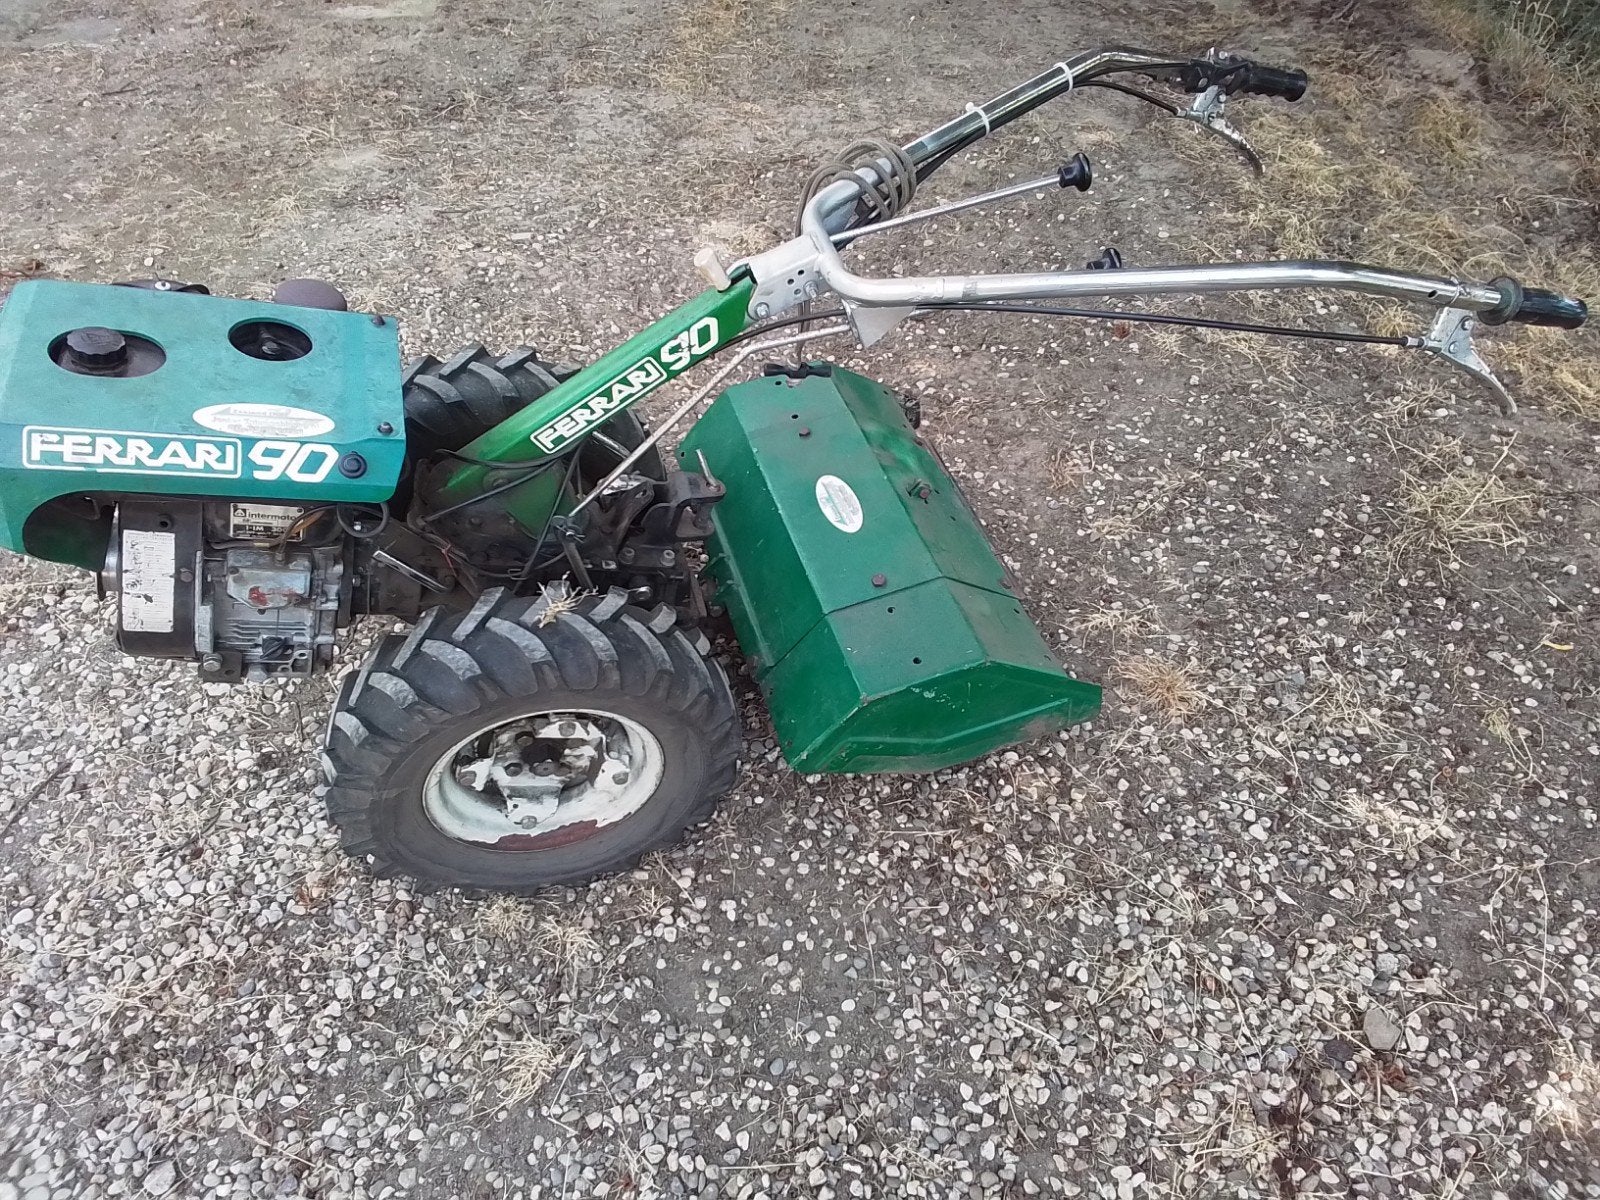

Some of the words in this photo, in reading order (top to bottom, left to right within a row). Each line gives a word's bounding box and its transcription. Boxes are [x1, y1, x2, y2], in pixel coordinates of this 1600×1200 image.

[535, 363, 662, 449] FERRARI
[660, 316, 719, 371] 90
[30, 433, 236, 471] FERRARI
[247, 440, 339, 483] 90
[248, 512, 298, 522] intermoto
